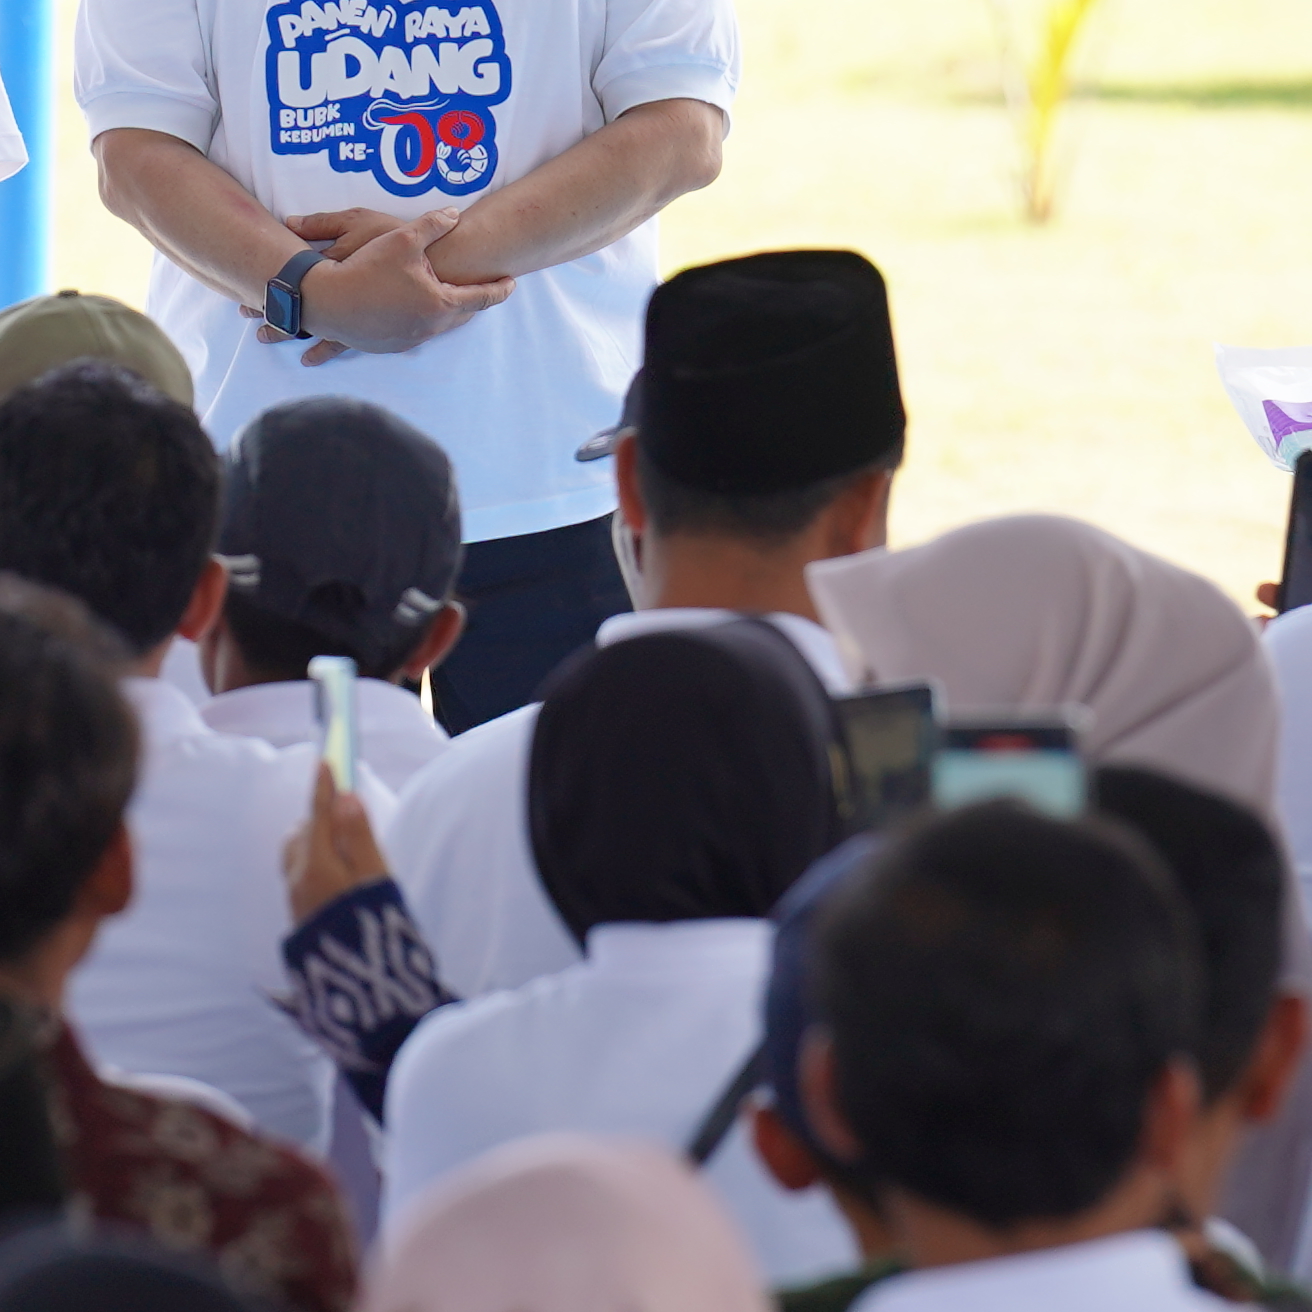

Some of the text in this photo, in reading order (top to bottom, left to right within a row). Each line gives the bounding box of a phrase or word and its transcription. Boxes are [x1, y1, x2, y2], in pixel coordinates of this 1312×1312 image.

[404, 5, 491, 43] RAYA
[277, 36, 500, 108] UDANG
[279, 103, 341, 128] BUBK
[279, 123, 355, 144] KEBUMEN
